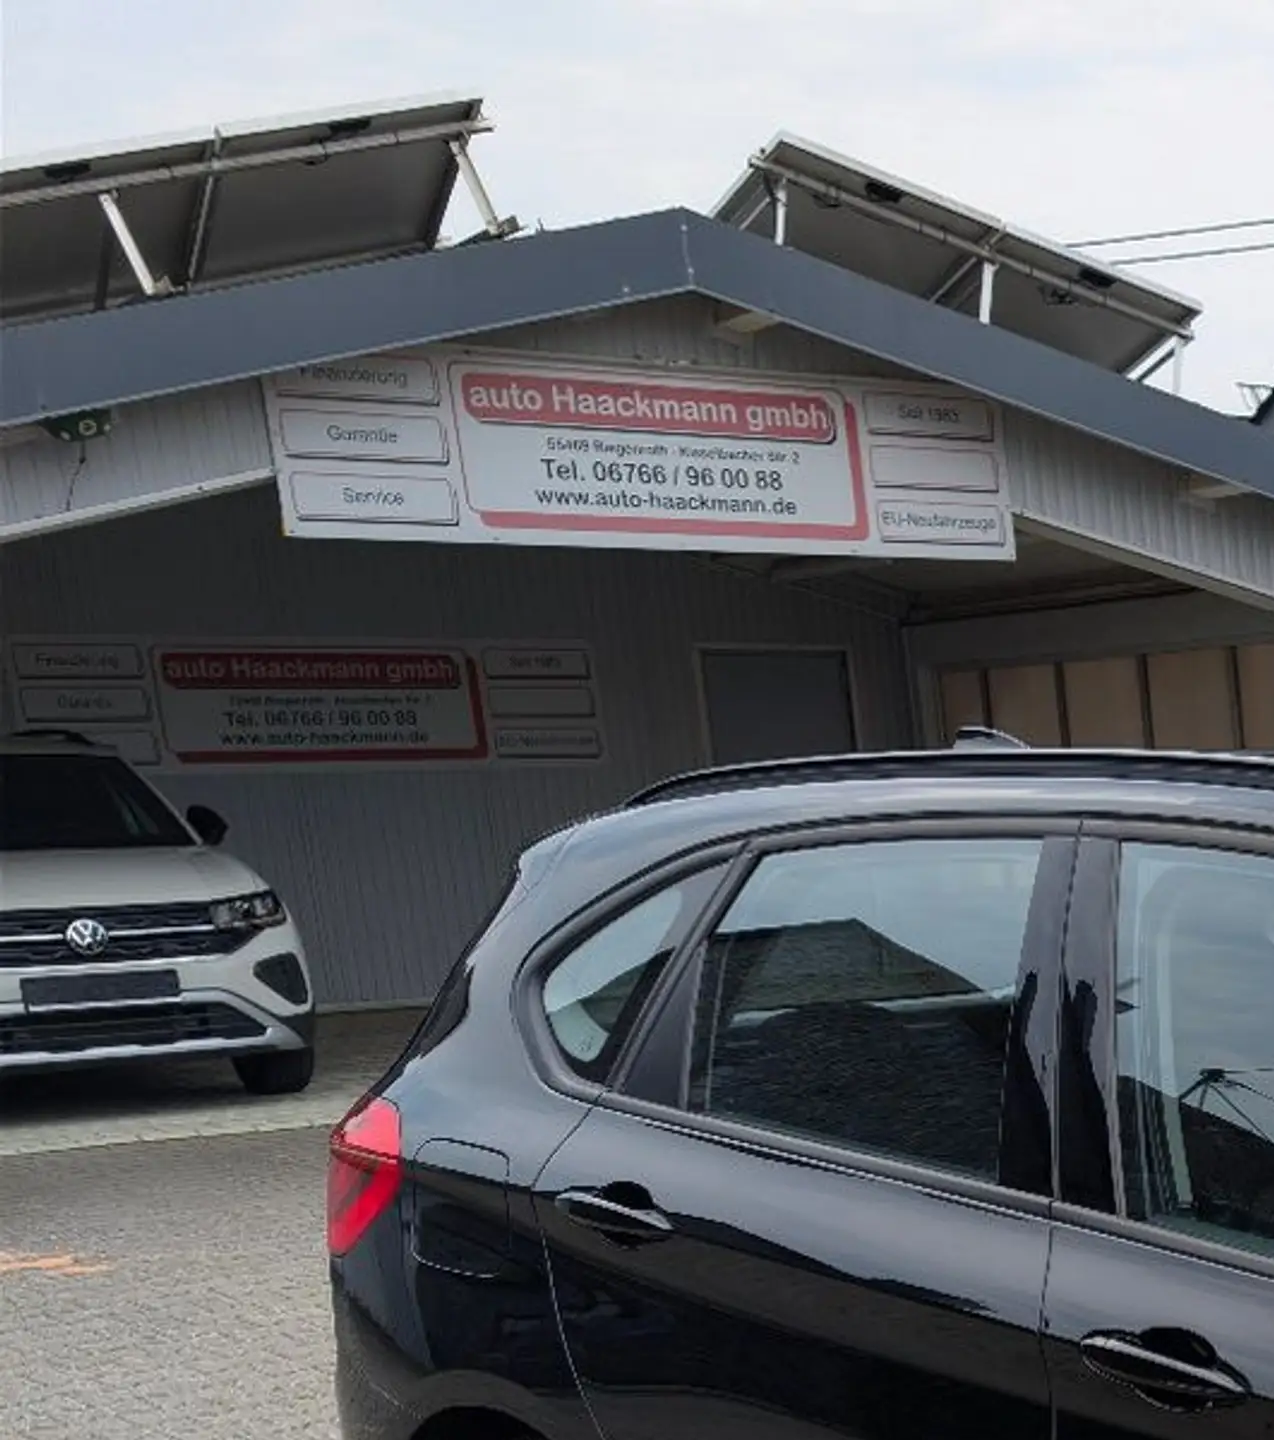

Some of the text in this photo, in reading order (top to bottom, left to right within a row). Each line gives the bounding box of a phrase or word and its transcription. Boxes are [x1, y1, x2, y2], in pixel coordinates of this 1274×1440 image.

[469, 385, 831, 431] auto Haackmann gmbh
[540, 458, 586, 481] Tel.
[592, 460, 667, 486] 06766
[686, 465, 715, 488] 96
[720, 467, 749, 489] 00
[755, 470, 784, 492] 88
[535, 487, 797, 516] www.auto-haackmann.de
[167, 658, 453, 683] auto Haackmann gmbh
